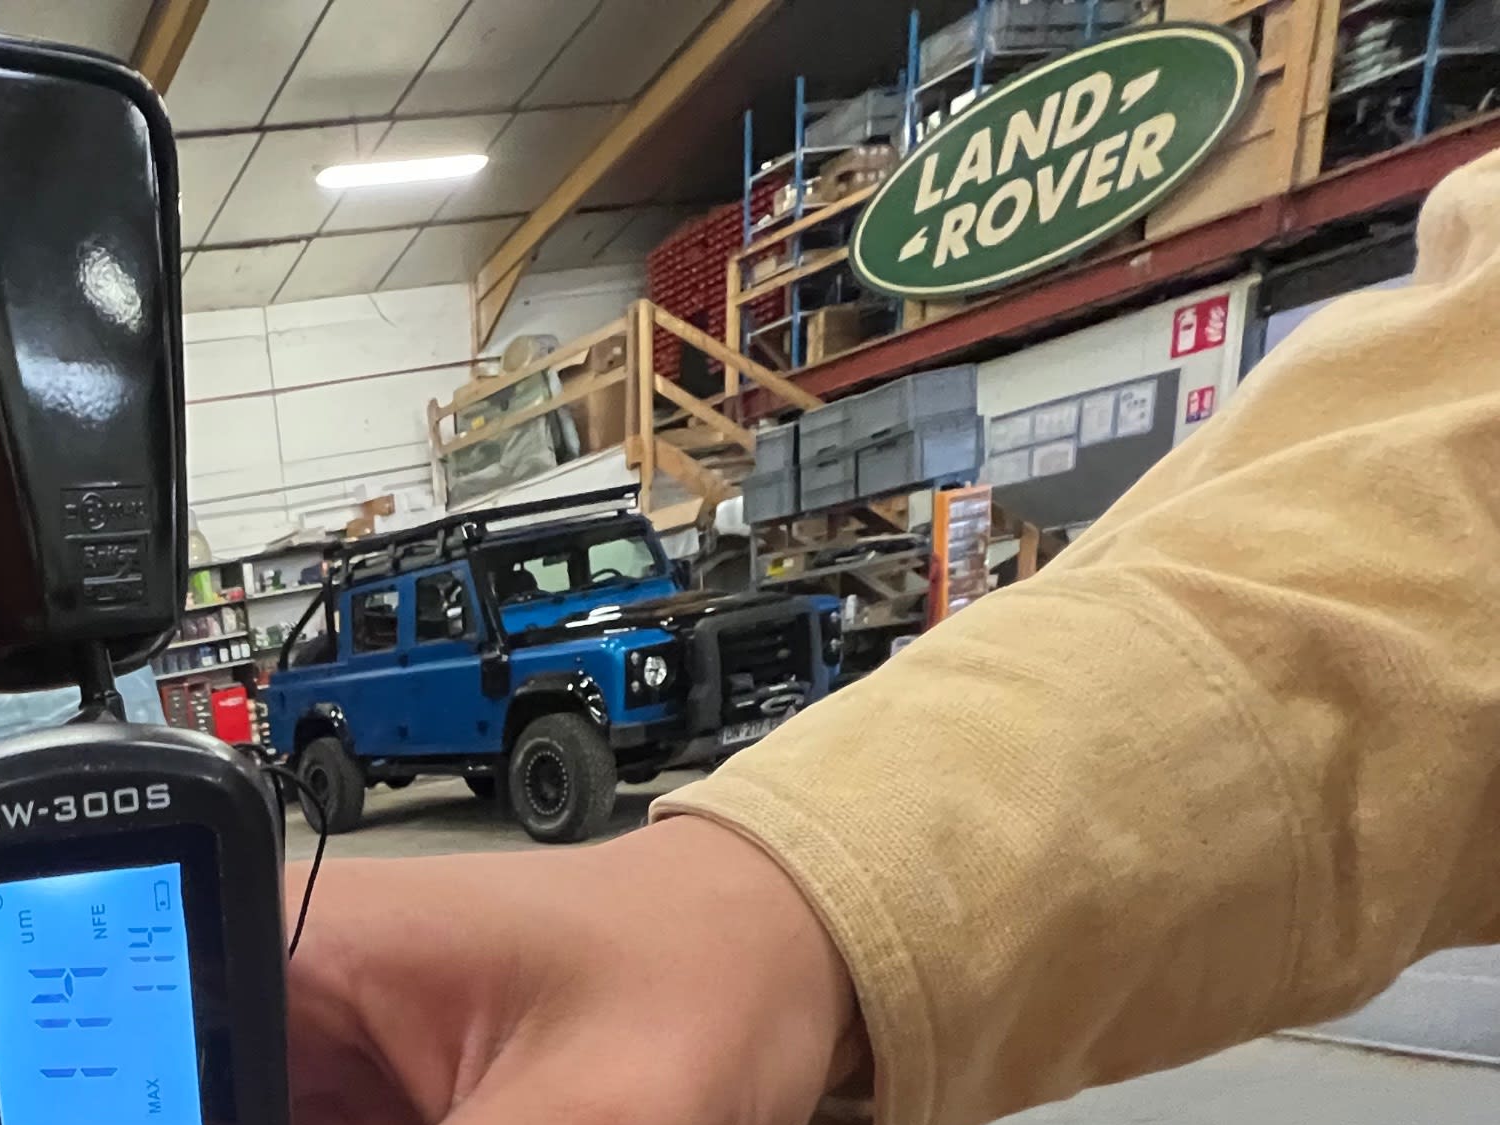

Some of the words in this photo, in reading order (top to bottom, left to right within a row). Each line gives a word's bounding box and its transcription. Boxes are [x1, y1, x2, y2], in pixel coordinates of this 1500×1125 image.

[914, 71, 1113, 215] LAND
[932, 112, 1177, 269] ROVER
[91, 903, 108, 940] NFE
[127, 926, 178, 992] 114
[28, 967, 118, 1078] 114
[146, 1078, 161, 1114] MAX
